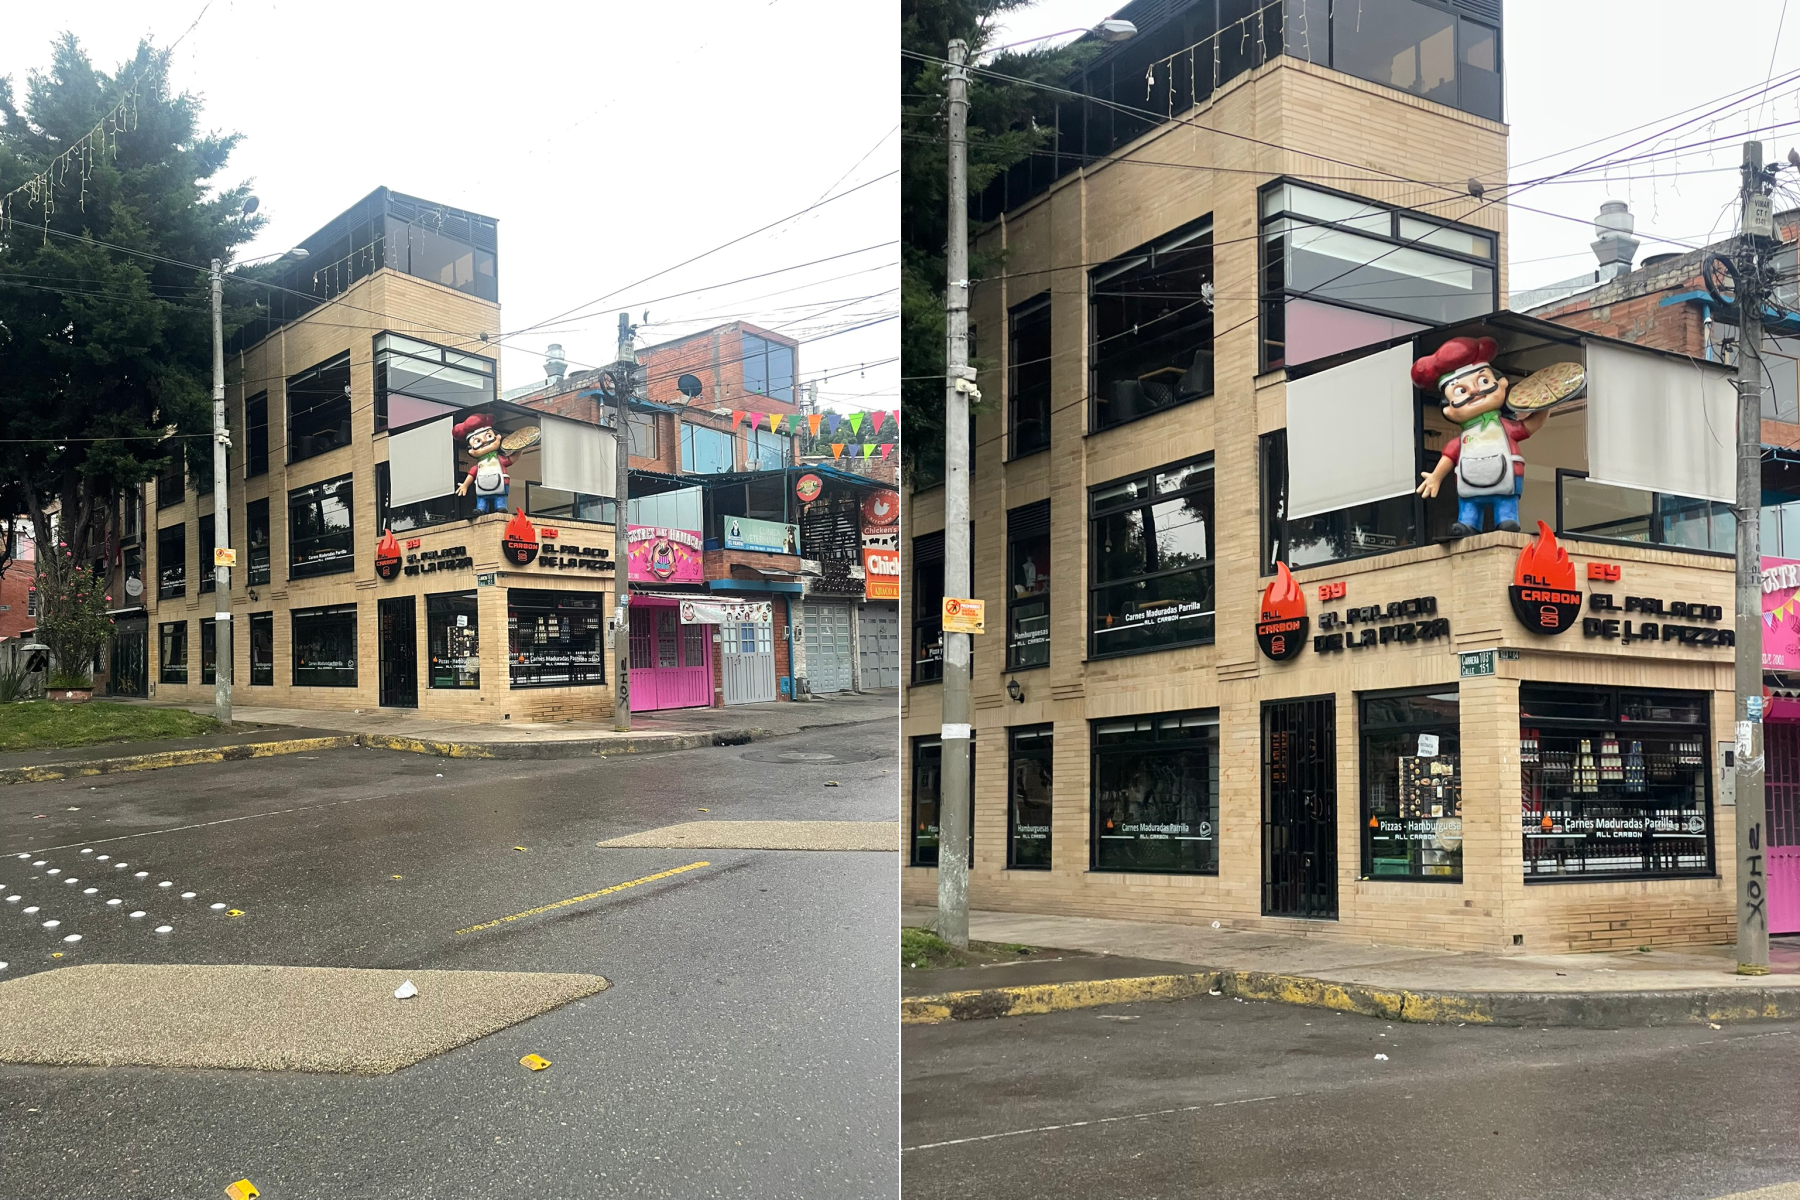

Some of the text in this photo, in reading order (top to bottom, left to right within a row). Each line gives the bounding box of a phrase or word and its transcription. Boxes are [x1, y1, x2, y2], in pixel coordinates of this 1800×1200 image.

[870, 516, 892, 525] KITCHEN
[541, 528, 558, 538] BY
[628, 528, 655, 543] OSTRES
[864, 526, 898, 534] Chicken's
[508, 542, 538, 550] CARBON
[745, 534, 781, 546] VETERINARIA
[542, 544, 559, 553] EL
[420, 562, 436, 573] LA
[539, 556, 615, 570] DE LA PIZZA
[1587, 562, 1621, 581] BY
[1523, 574, 1551, 587] ALL
[1318, 581, 1346, 601] BY
[1521, 589, 1580, 605] CARBON
[1125, 601, 1200, 622] Carnes Maduradas Parrilla
[1318, 596, 1437, 630] EL PALACIO
[1590, 593, 1722, 621] EL PALACIO
[1157, 615, 1179, 624] CARBON
[1262, 611, 1282, 621] ALL
[1258, 620, 1300, 635] CARBON
[1583, 617, 1736, 647] DE LA PIZZA
[1014, 628, 1049, 640] Hamburguesas
[1314, 618, 1450, 653] DE LA PIZZA
[1461, 653, 1480, 665] CARRERA
[1772, 654, 1784, 665] 2001
[1461, 663, 1489, 676] CALLE 151
[1121, 823, 1190, 833] Carnes Maduradas Parrilla
[1380, 820, 1402, 831] Pizzas
[1565, 817, 1673, 829] Carnes Maduradas Parrilla
[1017, 824, 1050, 835] Hamburguesas
